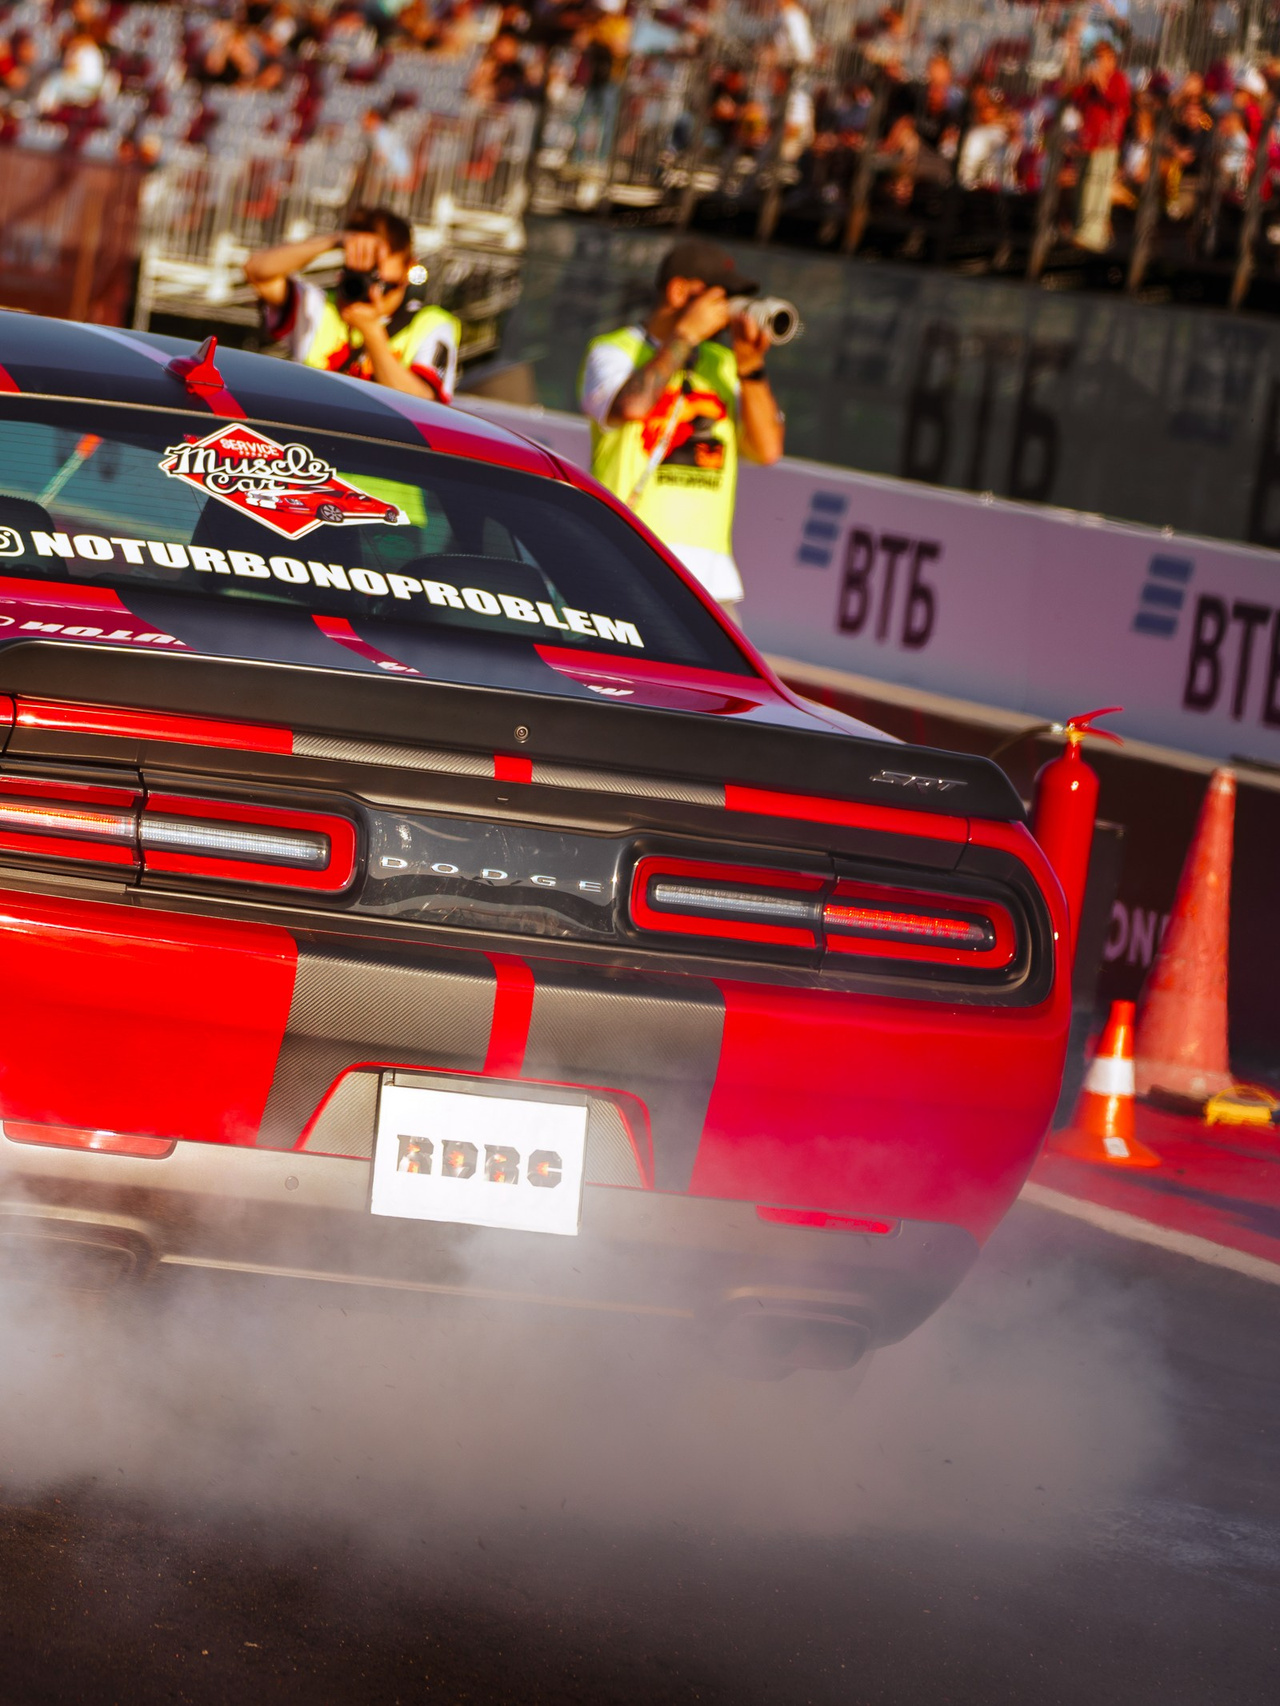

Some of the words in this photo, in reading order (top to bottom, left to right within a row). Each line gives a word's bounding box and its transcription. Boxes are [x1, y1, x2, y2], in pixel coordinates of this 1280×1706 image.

[172, 446, 333, 485] Muscle
[219, 438, 280, 457] SERVICE
[207, 470, 286, 494] Car
[30, 530, 645, 648] NOTURBONOPROBLEM
[837, 528, 942, 650] ВТБ
[1183, 592, 1280, 730] ВТ
[379, 856, 604, 893] DODGE
[396, 1134, 563, 1189] RDRC
